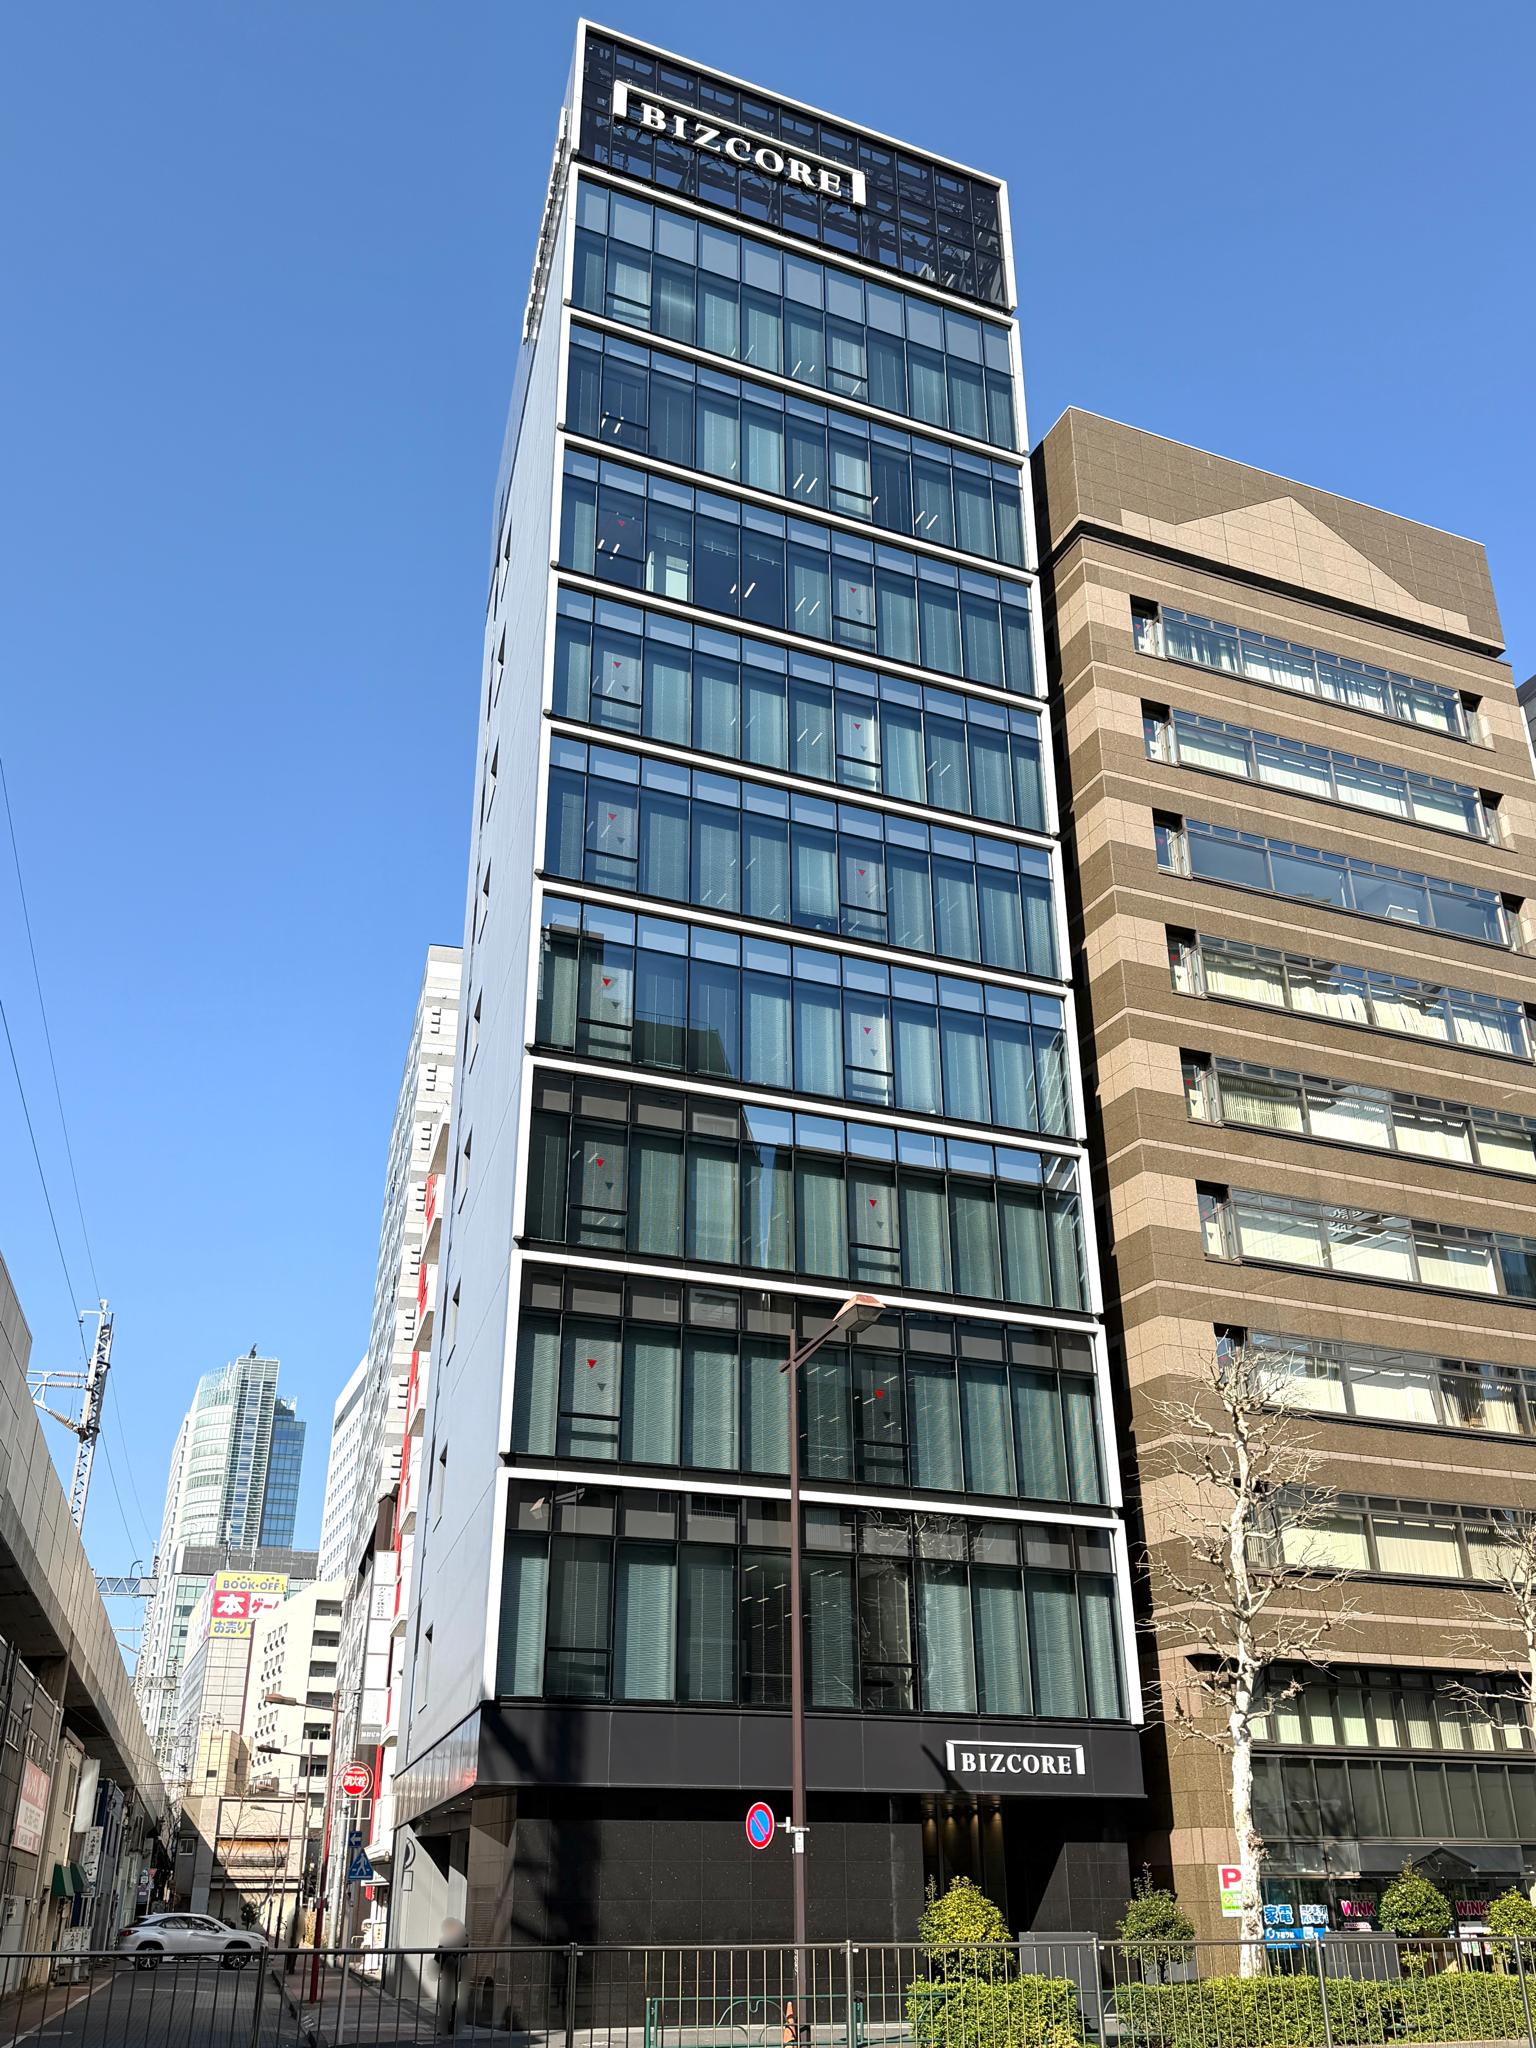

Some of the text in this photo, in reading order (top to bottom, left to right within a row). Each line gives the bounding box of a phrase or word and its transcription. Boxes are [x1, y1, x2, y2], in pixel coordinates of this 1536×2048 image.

[640, 102, 842, 198] BIZCORE
[216, 1594, 246, 1616] 本
[960, 1752, 1073, 1775] BIZCORE
[1221, 1868, 1242, 1889] P
[1263, 1904, 1294, 1925] 家電
